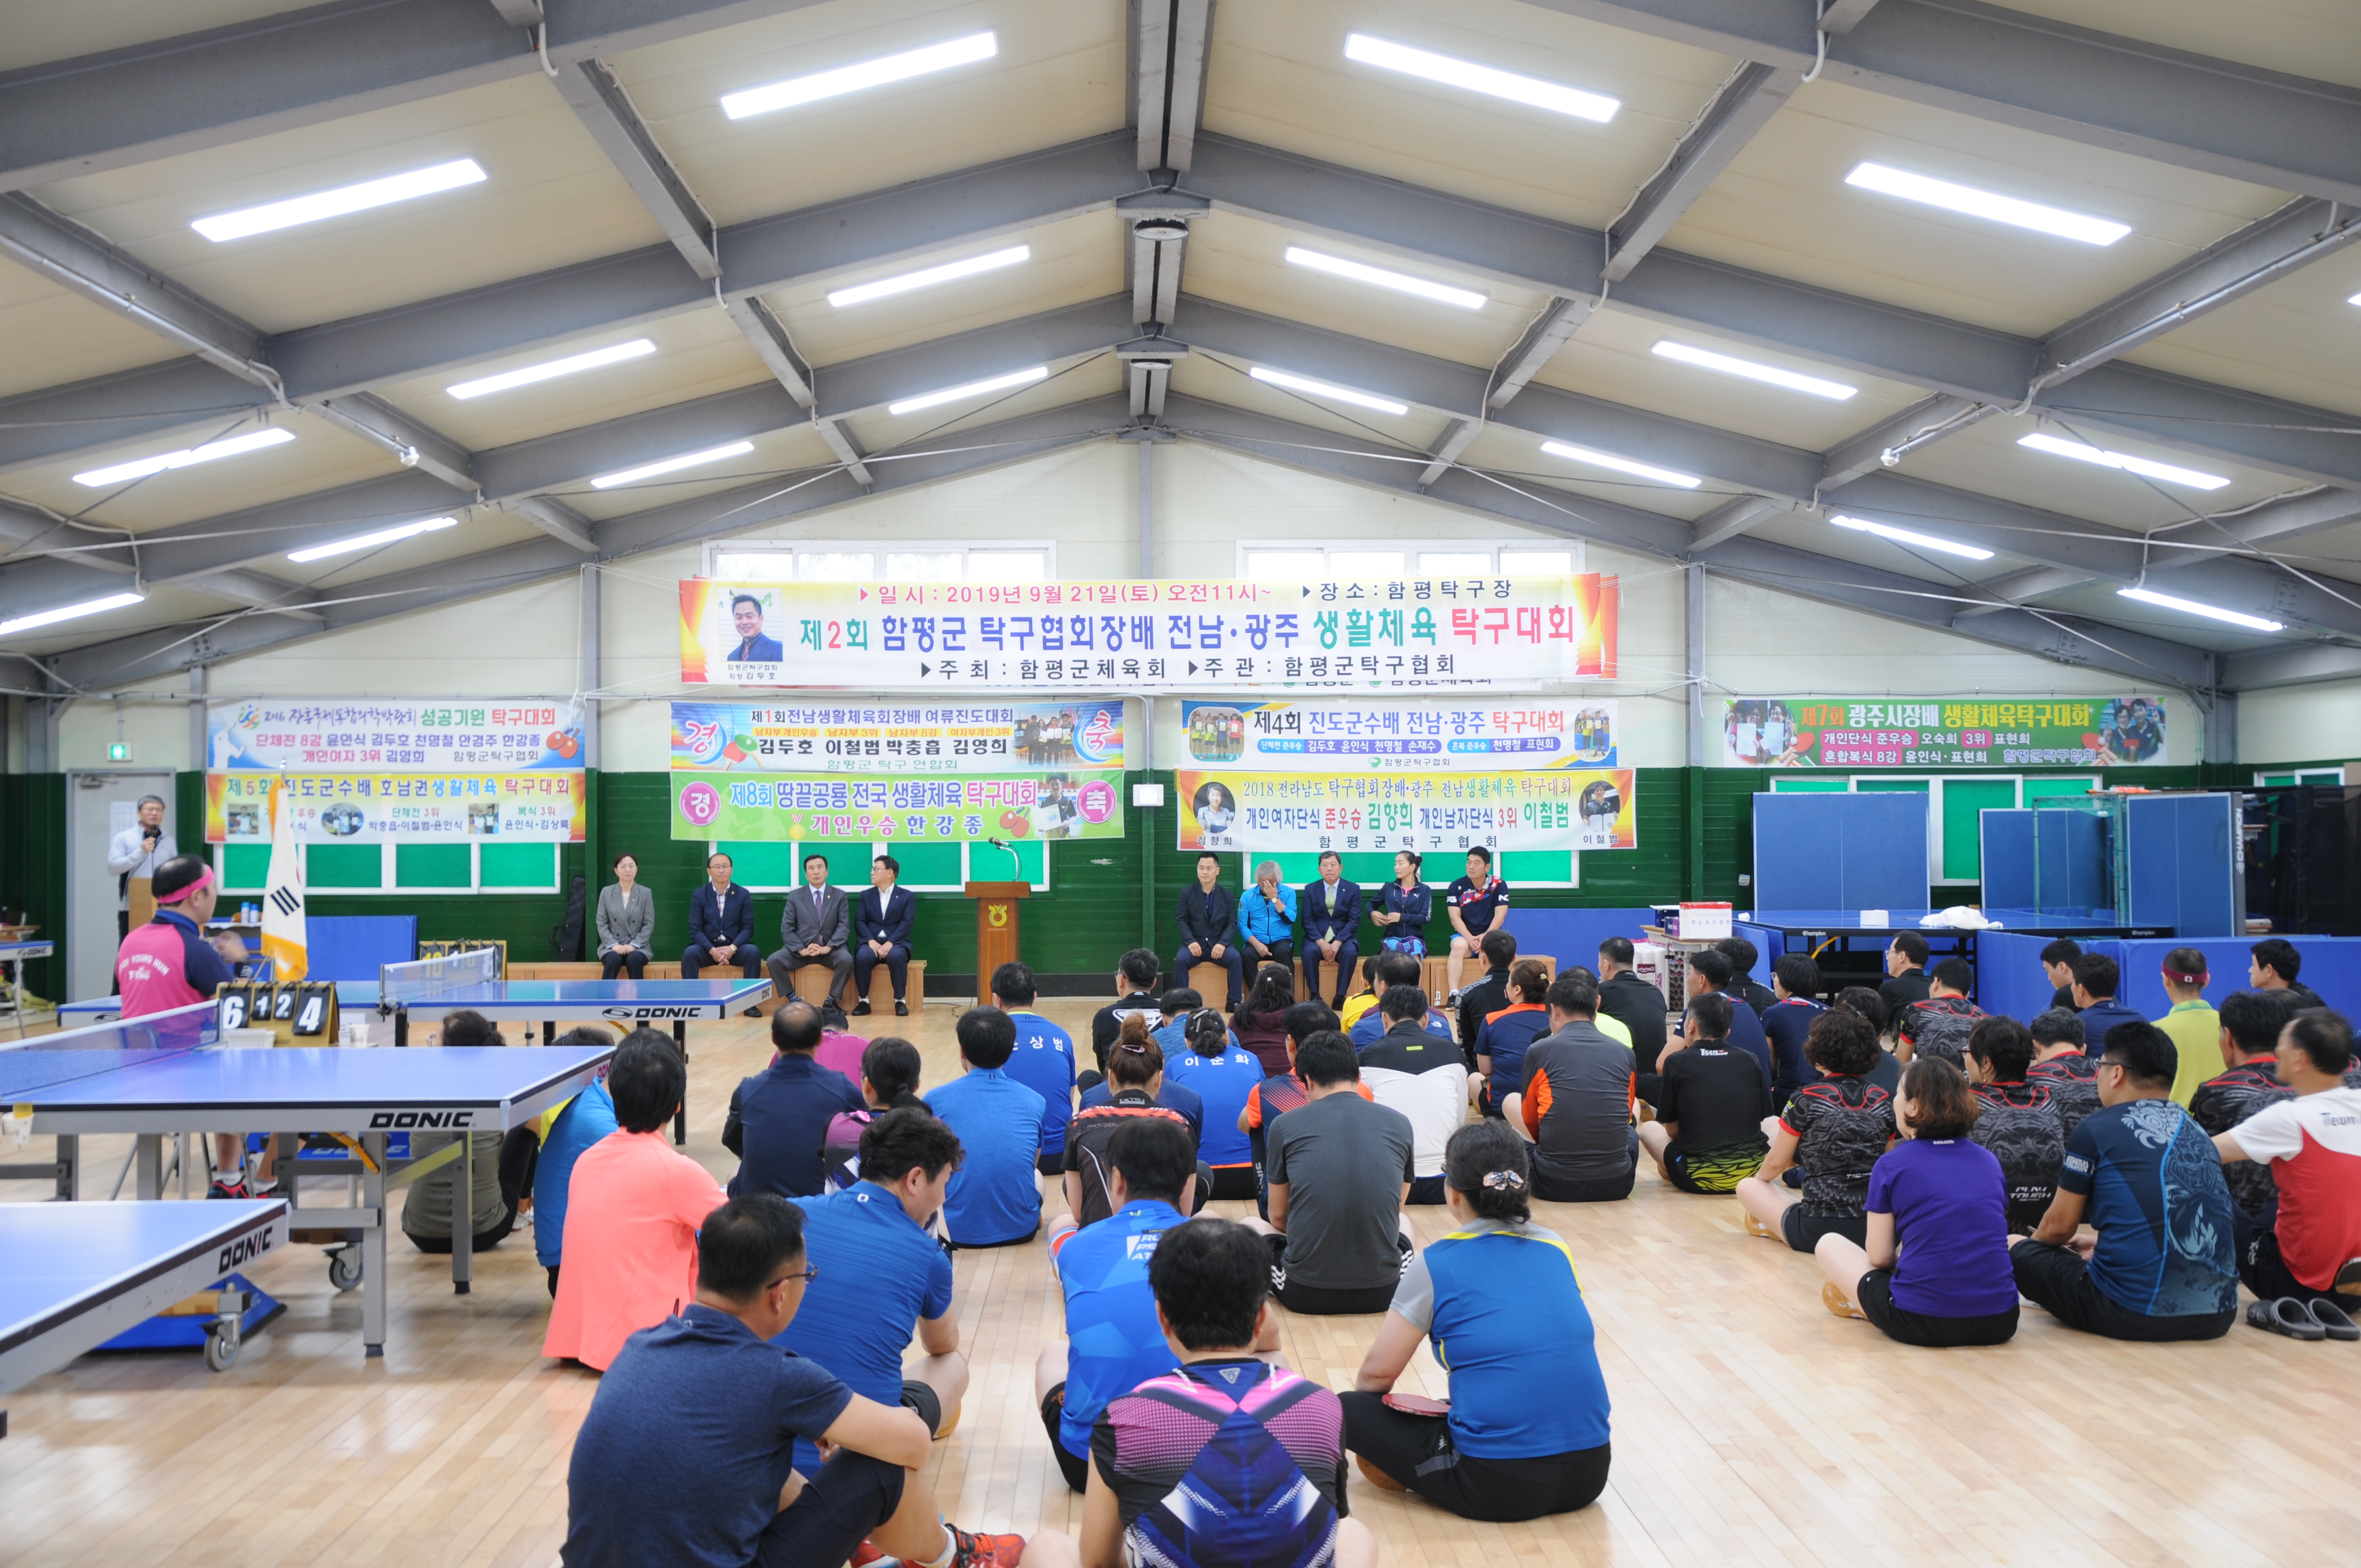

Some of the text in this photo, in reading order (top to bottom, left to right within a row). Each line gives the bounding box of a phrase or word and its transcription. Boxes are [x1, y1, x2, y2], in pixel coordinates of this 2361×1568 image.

[947, 585, 1021, 603] 2019년
[1030, 585, 1062, 604] 9월
[1071, 584, 1158, 603] 21일(토)
[1168, 584, 1271, 602] 오전11시~
[1388, 579, 1511, 600] 함평탁구장
[801, 605, 1573, 653] 제2회 함평군 탁구협회장배 전남·광주 생활체육 탁구대회
[1020, 658, 1165, 679] 함평군체육회
[1285, 654, 1454, 677] 함평군탁구협회
[265, 711, 285, 721] 2016
[421, 708, 485, 726] 성공기원
[492, 708, 556, 726] 탁구대회
[925, 708, 1014, 725] 여류진도대회
[1254, 711, 1301, 734] 제4회
[1309, 711, 1399, 735] 진도군수배
[1492, 710, 1564, 733] 탁구대회
[1801, 703, 2090, 728] 제7회 광주시장배 생활체육탁구대회
[686, 721, 717, 754] 경
[755, 728, 817, 737] 남자부 개인우승
[828, 728, 878, 737] 남자부 3위
[889, 728, 938, 737] 남자부 8강
[996, 727, 1010, 736] 3위
[1085, 710, 1115, 752] 축
[1824, 732, 2031, 745] 개인단식 준우승 오숙희 3위 표현희
[256, 734, 296, 747] 단체전
[300, 734, 322, 747] 8강
[372, 733, 410, 747] 김두호
[415, 734, 454, 747] 천명철
[459, 734, 497, 748] 안경주
[502, 734, 541, 747] 한강종
[758, 739, 813, 755] 김두호
[825, 739, 880, 755] 이철범
[953, 738, 1007, 755] 김영희
[1261, 740, 1437, 753] 단체전 준우승 김두호 윤인식 천명철 손재수
[1467, 742, 1487, 750] 준우승
[1493, 739, 1521, 751] 천명철
[1526, 738, 1554, 749] 표현희
[303, 749, 425, 763] 개인여자 3위 김영희
[828, 759, 958, 770] 함평군 탁구 연합회
[1824, 750, 1873, 763] 혼합복식
[1876, 750, 1897, 763] 8강
[2004, 749, 2096, 763] 함평군탁구협회
[227, 778, 272, 797] 제5회
[505, 778, 569, 796] 탁구대회
[731, 780, 1037, 808] 제8회 땅끝공룡 전국 생활체육 탁구대회
[1243, 781, 1274, 797] 2018
[1277, 780, 1325, 798] 전라남도
[1521, 777, 1571, 797] 탁구대회
[540, 805, 556, 816] 3위
[690, 792, 711, 818] 경
[1086, 790, 1107, 814] 축
[392, 807, 439, 818] 단체전 3위
[1246, 801, 1569, 832] 개인여자단식 준우승 김향희 개인남자단식 3위 이철범
[811, 814, 984, 836] 개인우승 한강종
[1197, 835, 1233, 846] 김향희
[1583, 834, 1618, 845] 이철범
[2235, 808, 2244, 862] CHAMPION
[223, 994, 323, 1031] 6 1 2 4
[635, 1007, 701, 1017] DONIC
[1013, 1035, 1064, 1052] 상범
[369, 1112, 474, 1128] DONIC
[218, 1226, 273, 1275] DONIC
